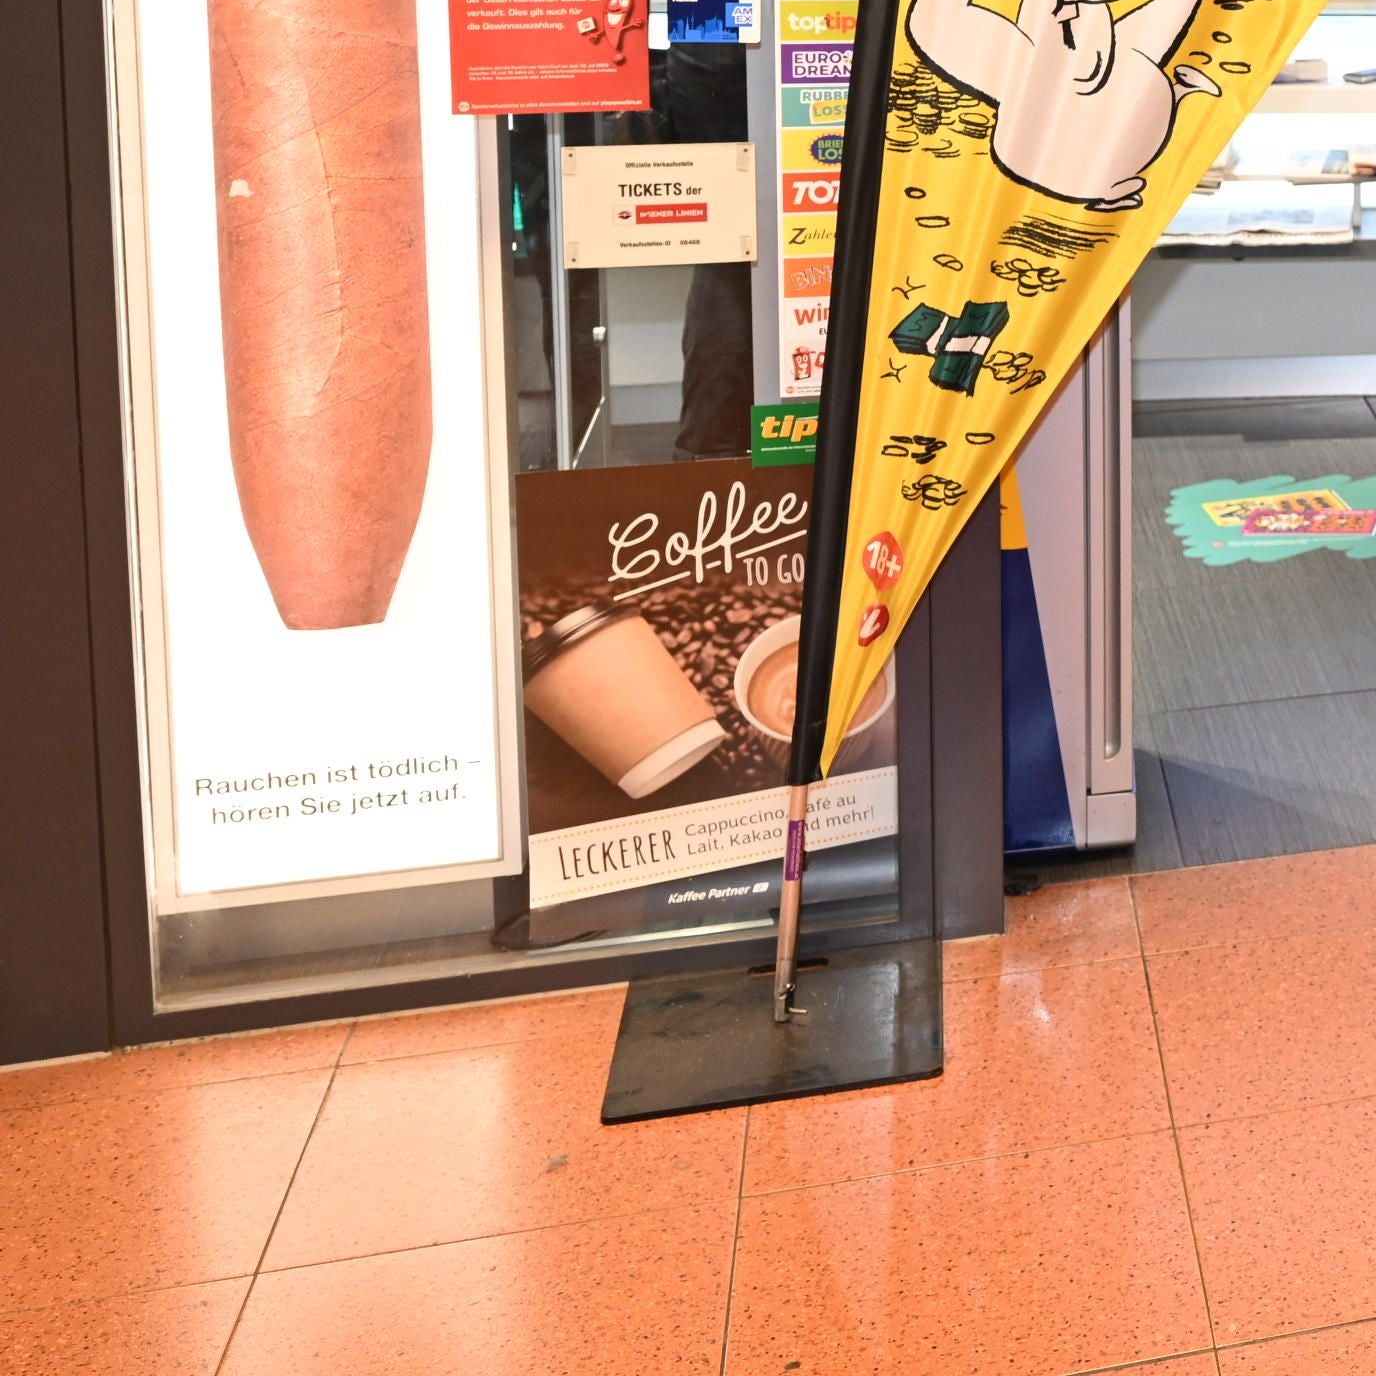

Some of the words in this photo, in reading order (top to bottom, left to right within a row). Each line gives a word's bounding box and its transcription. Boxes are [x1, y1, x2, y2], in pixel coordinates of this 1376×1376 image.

[466, 9, 506, 17] verkauft.
[508, 8, 528, 16] Dies
[529, 8, 545, 19] gilt
[569, 7, 583, 15] für
[794, 53, 842, 64] EURO
[617, 182, 683, 197] TICKETS
[686, 185, 703, 196] der
[639, 210, 674, 218] WIENER
[676, 209, 703, 217] LINIEN
[608, 481, 809, 584] Coffee
[743, 556, 769, 586] TO
[777, 552, 805, 584] GO
[866, 539, 902, 578] 18+
[195, 771, 317, 797] Rauchen
[326, 765, 359, 784] ist
[367, 755, 459, 780] tödlich
[211, 802, 291, 825] hören
[300, 796, 341, 816] Sie
[350, 787, 410, 814] jetzt
[418, 782, 467, 804] auf.
[685, 807, 789, 840] Cappuccino,
[836, 793, 857, 808] au
[687, 836, 726, 857] Lait,
[729, 826, 783, 848] Kakao
[825, 804, 875, 827] mehr!
[558, 828, 677, 881] LECKERER
[667, 888, 707, 905] Kaffee
[707, 882, 751, 900] Partner
